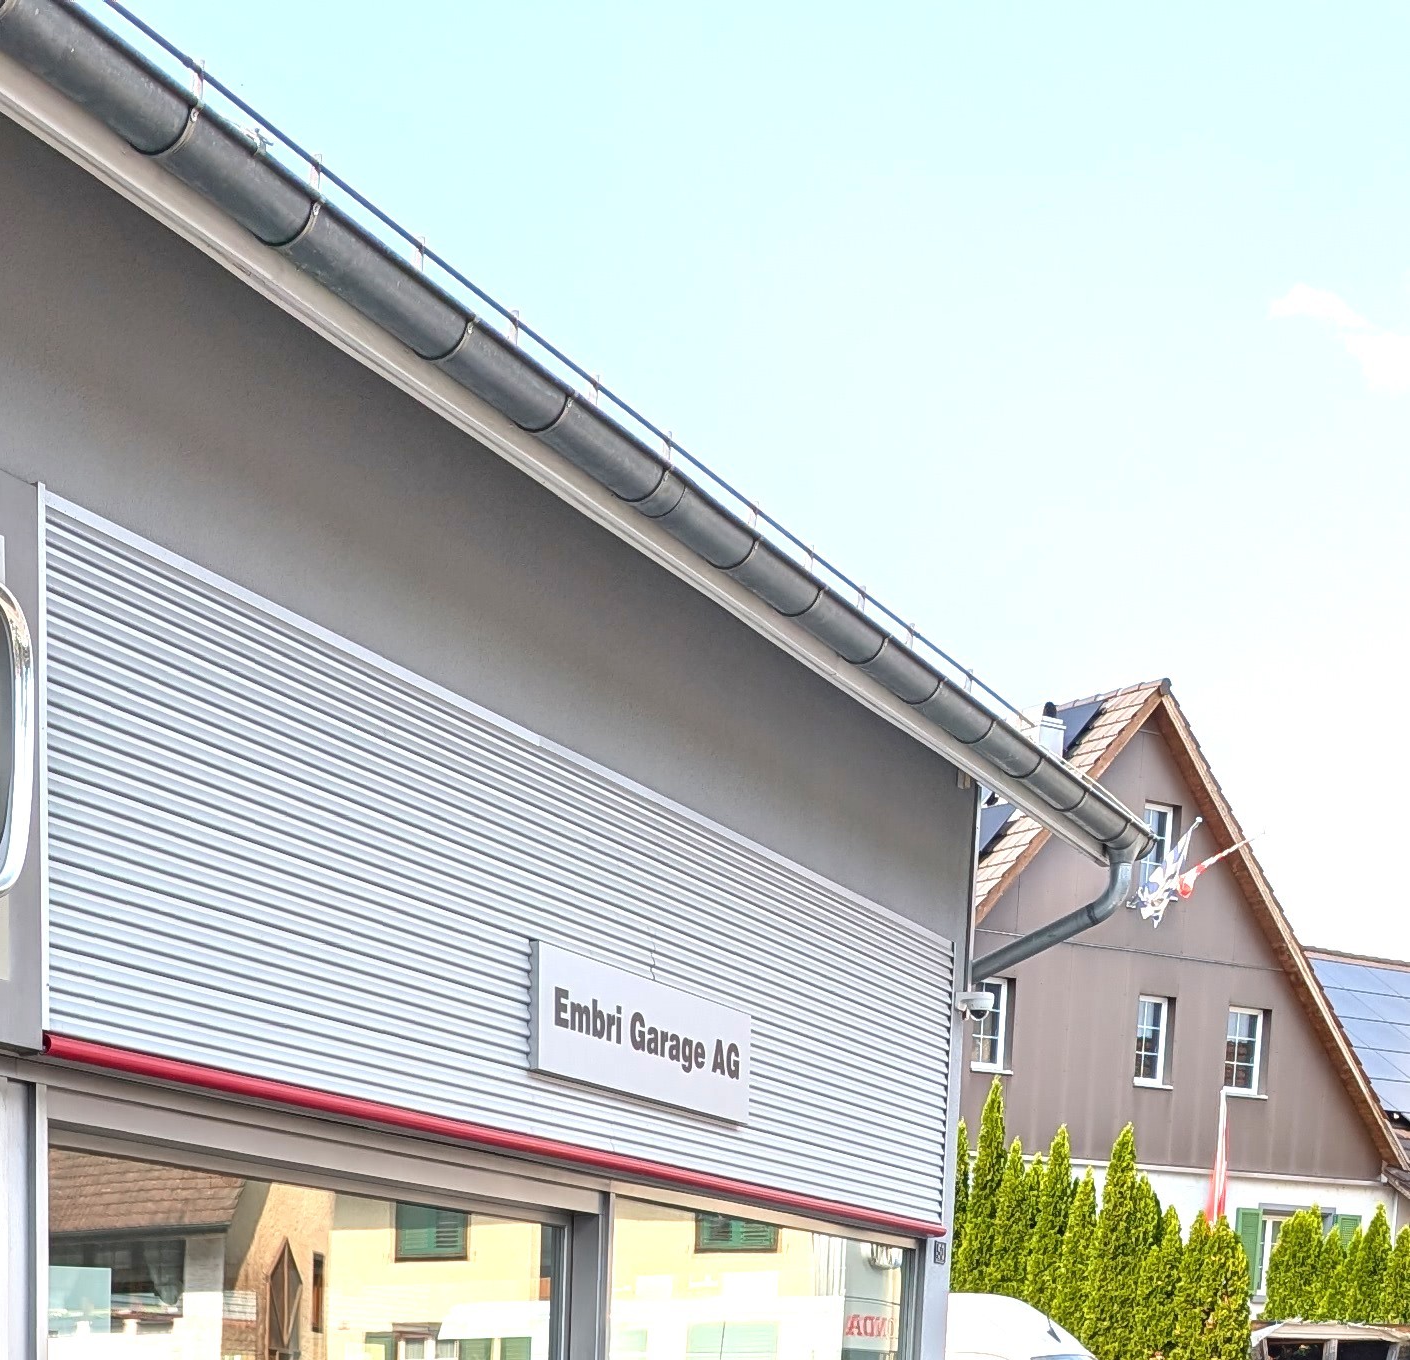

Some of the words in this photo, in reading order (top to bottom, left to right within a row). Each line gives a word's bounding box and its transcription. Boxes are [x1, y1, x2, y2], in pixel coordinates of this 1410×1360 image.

[554, 986, 622, 1045] Embri
[630, 1011, 706, 1074] Garage
[712, 1038, 740, 1080] AG
